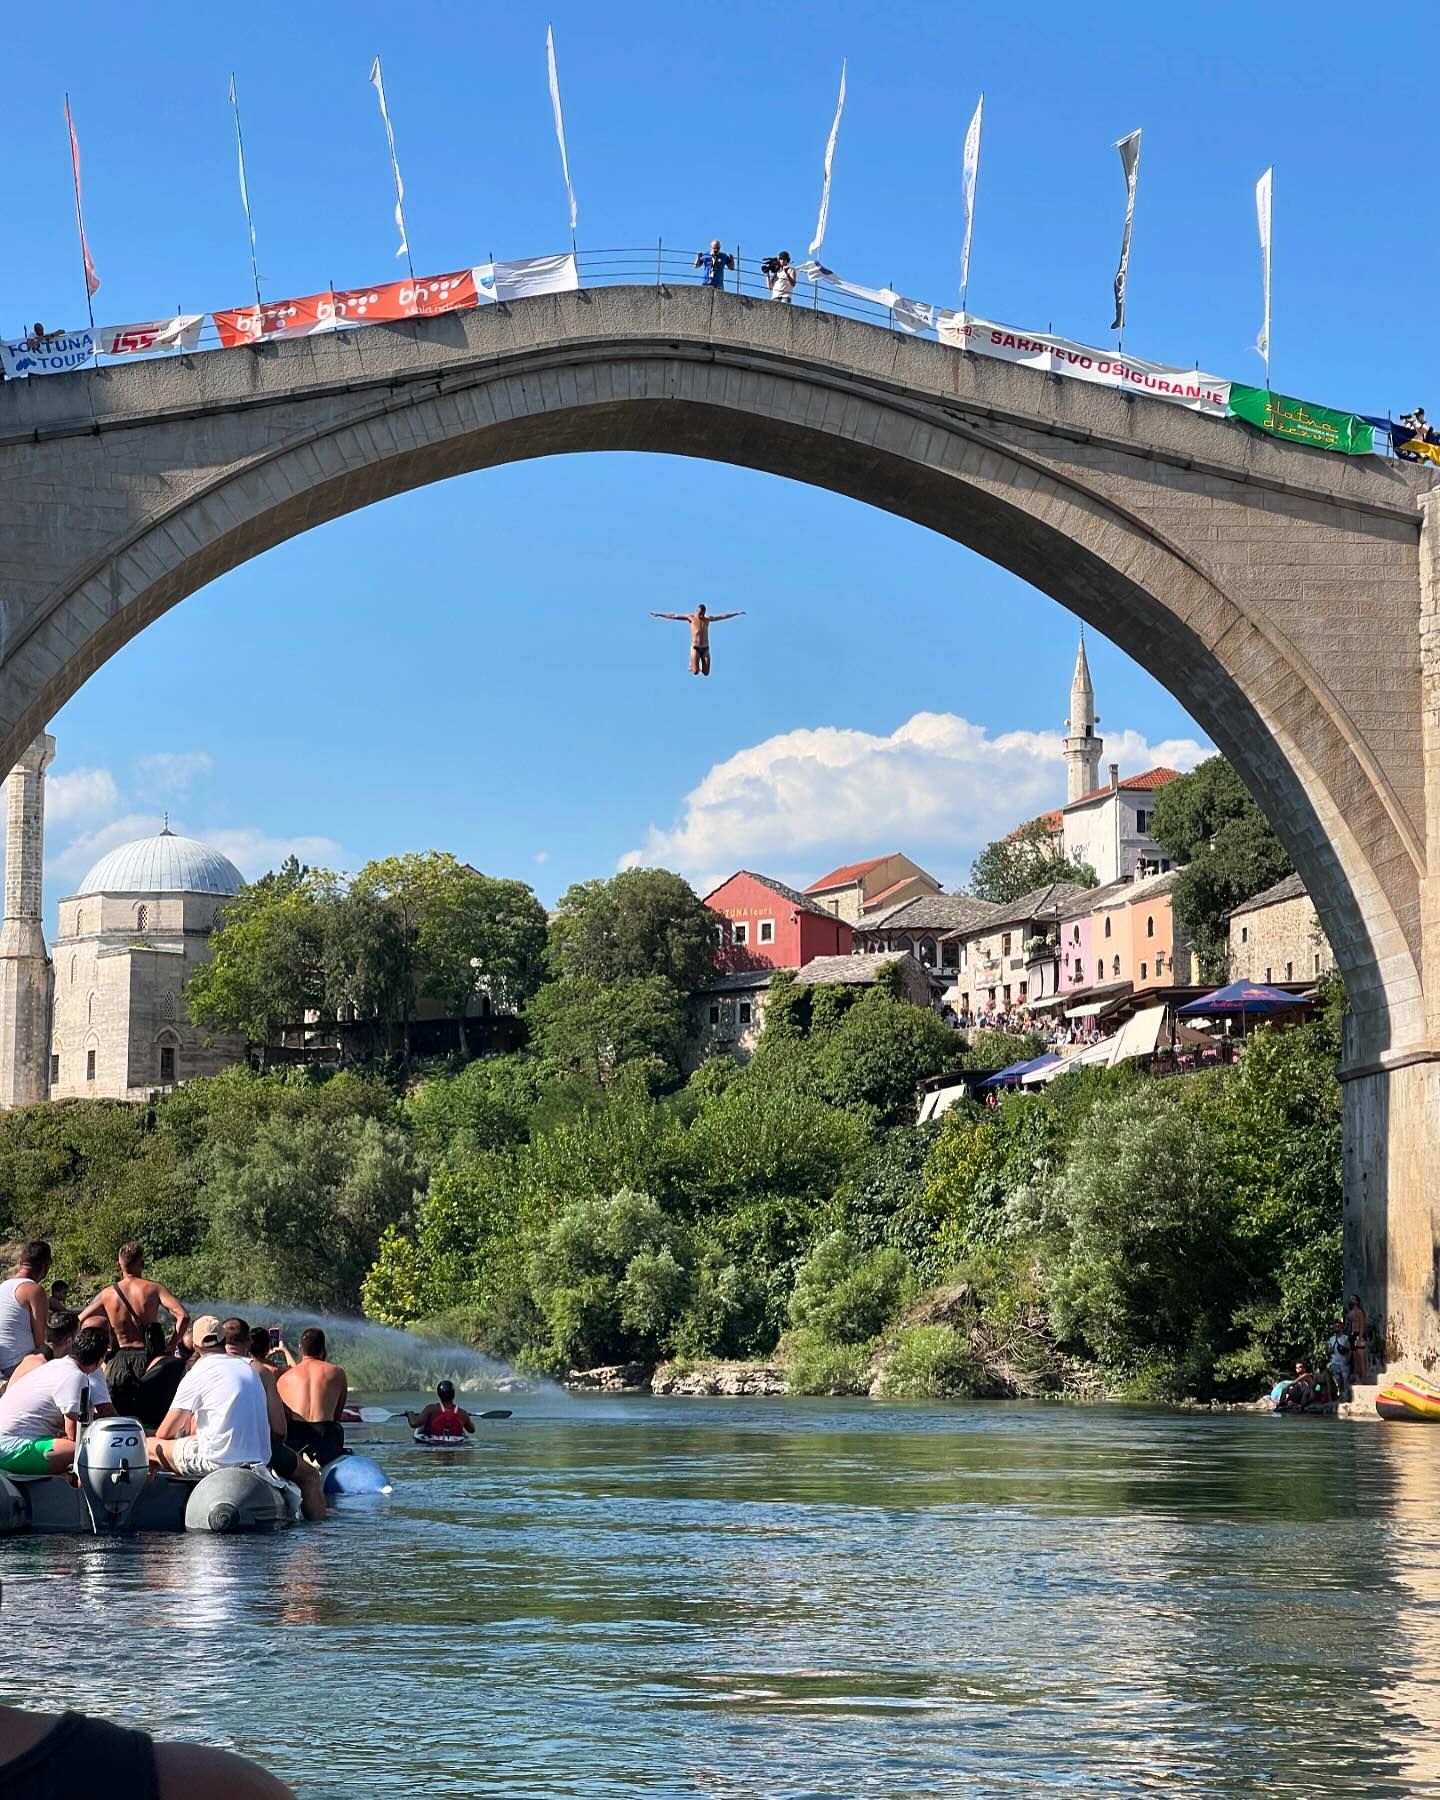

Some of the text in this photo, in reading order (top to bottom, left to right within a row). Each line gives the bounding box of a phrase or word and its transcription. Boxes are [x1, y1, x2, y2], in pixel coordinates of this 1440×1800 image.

[1098, 361, 1223, 405] OSIGURANJE
[1265, 401, 1339, 433] zlatna
[110, 1436, 139, 1448] 20
